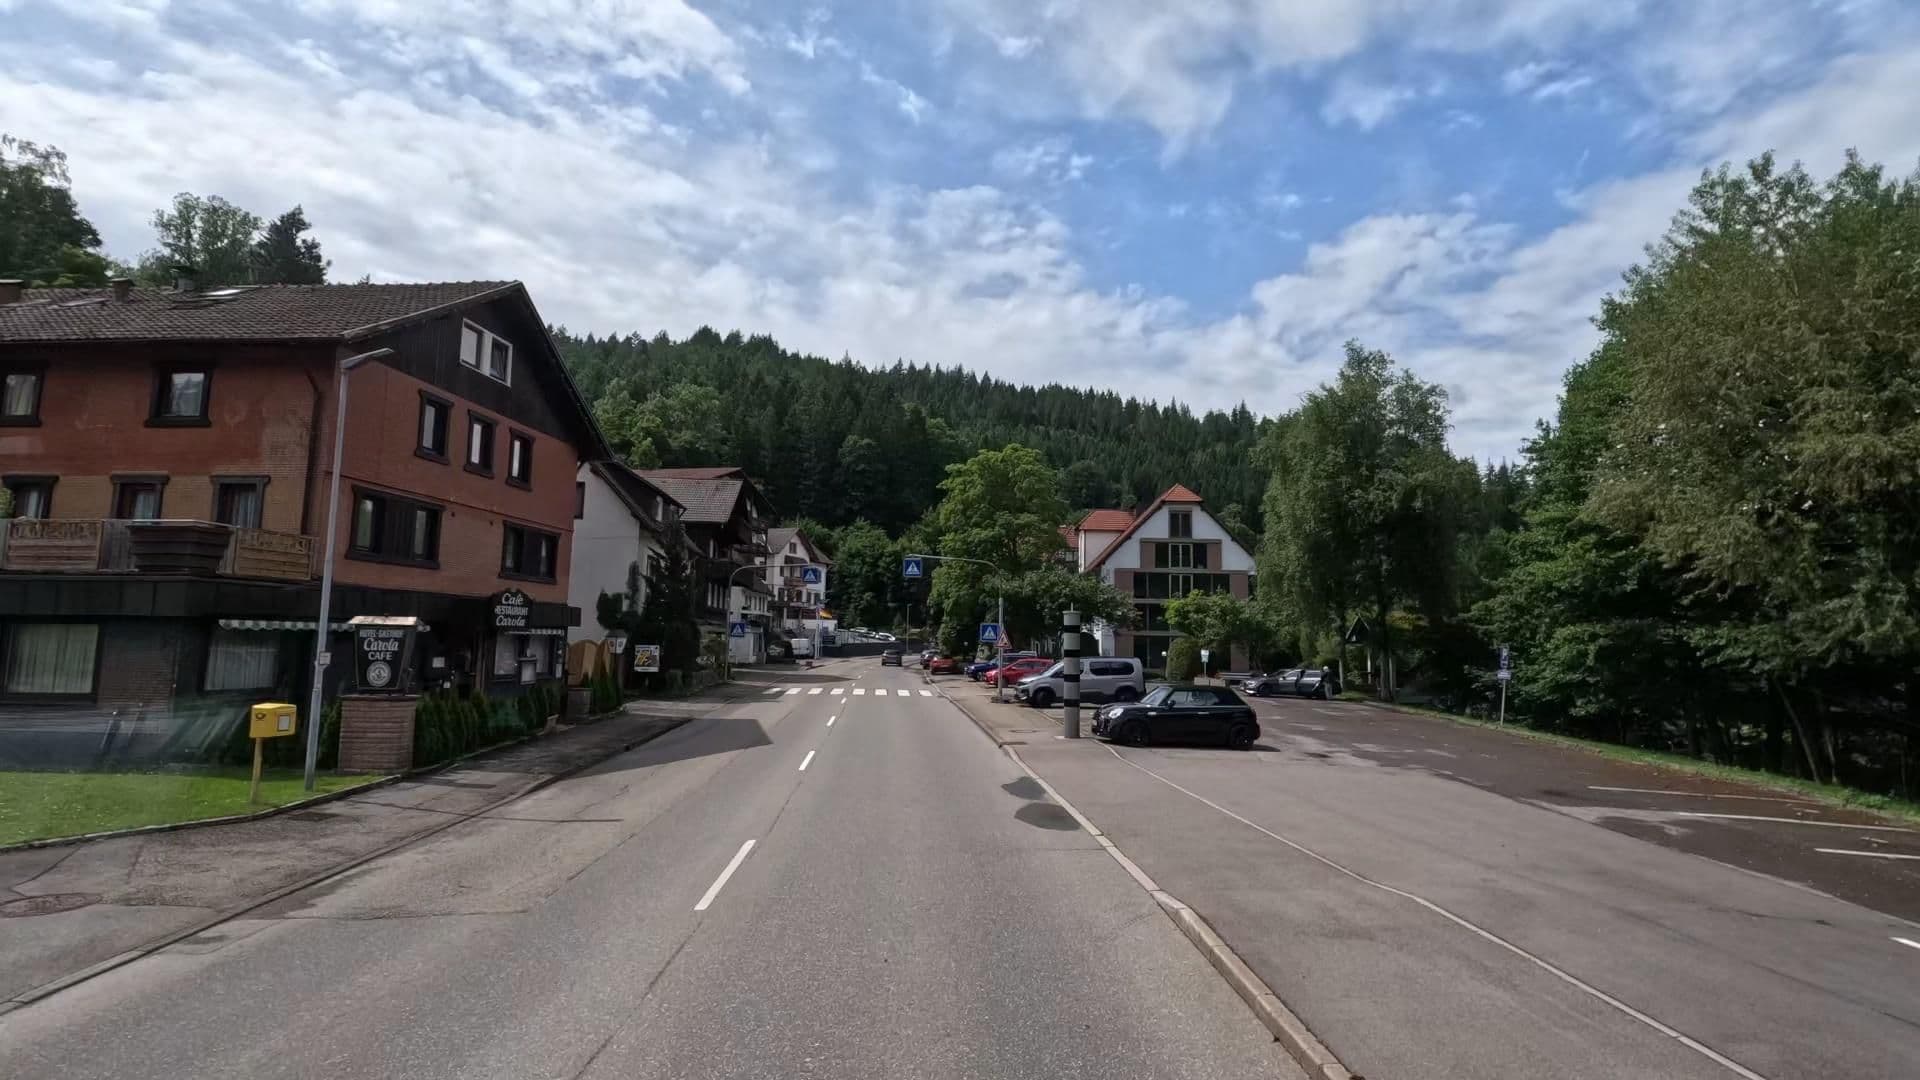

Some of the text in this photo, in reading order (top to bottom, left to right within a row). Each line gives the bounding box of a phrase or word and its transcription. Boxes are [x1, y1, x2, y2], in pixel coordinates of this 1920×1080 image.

[496, 615, 526, 626] Carola
[363, 637, 399, 651] Carola
[368, 651, 393, 661] CAFE
